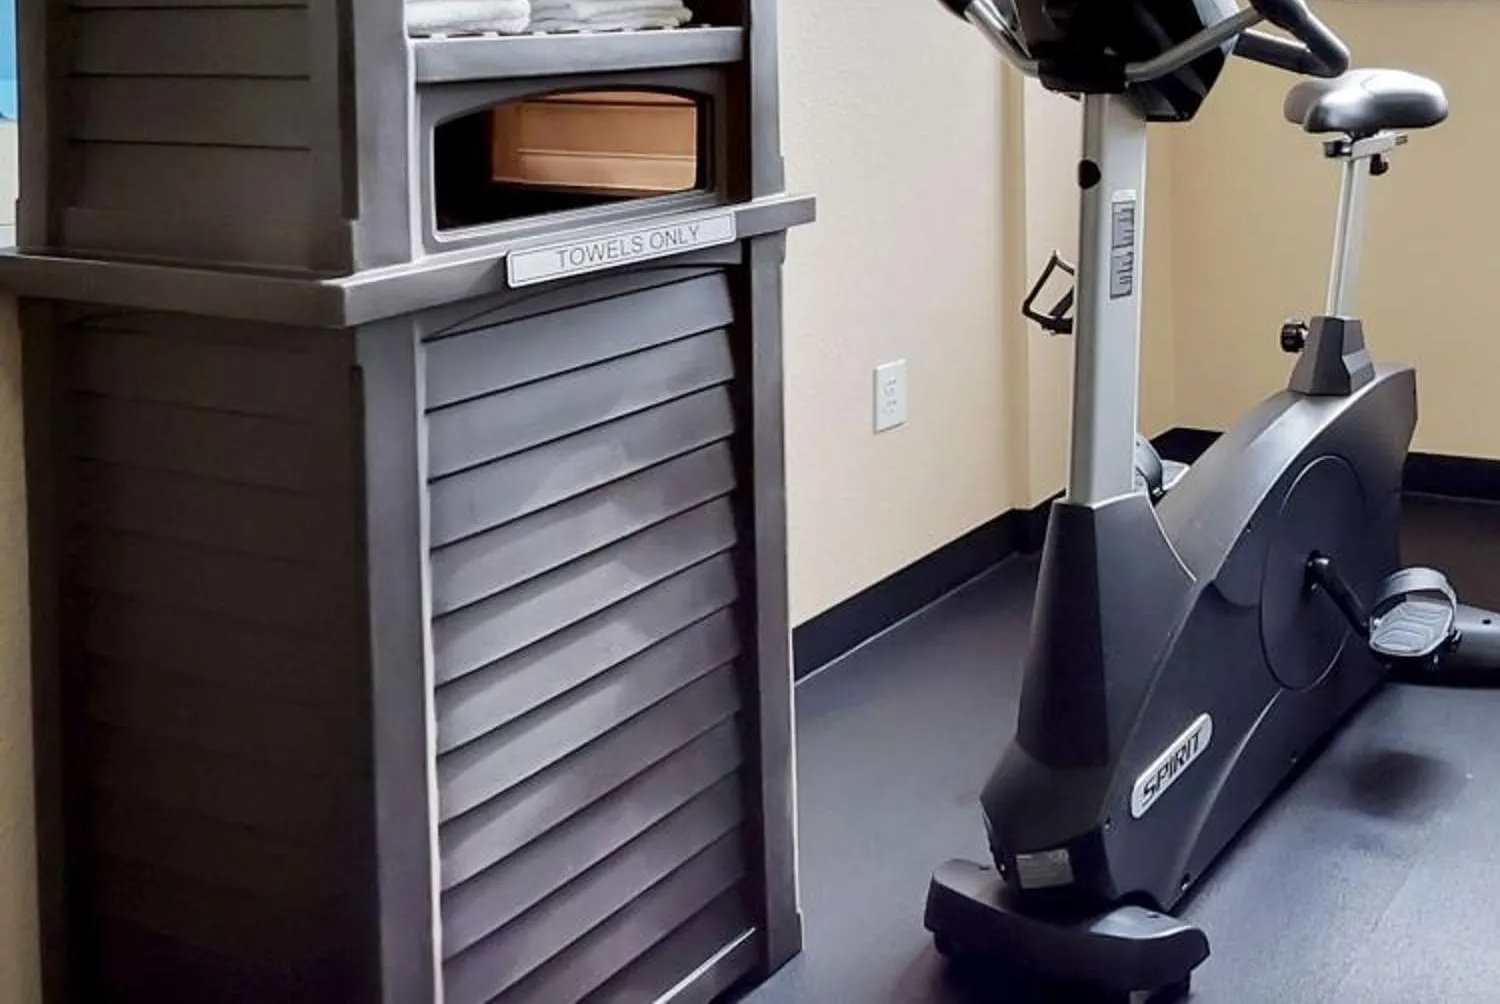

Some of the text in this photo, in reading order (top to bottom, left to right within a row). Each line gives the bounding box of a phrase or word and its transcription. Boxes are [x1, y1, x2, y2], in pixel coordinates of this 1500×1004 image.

[557, 224, 701, 269] TOWELS ONLY
[1140, 725, 1202, 808] SPIRIT
